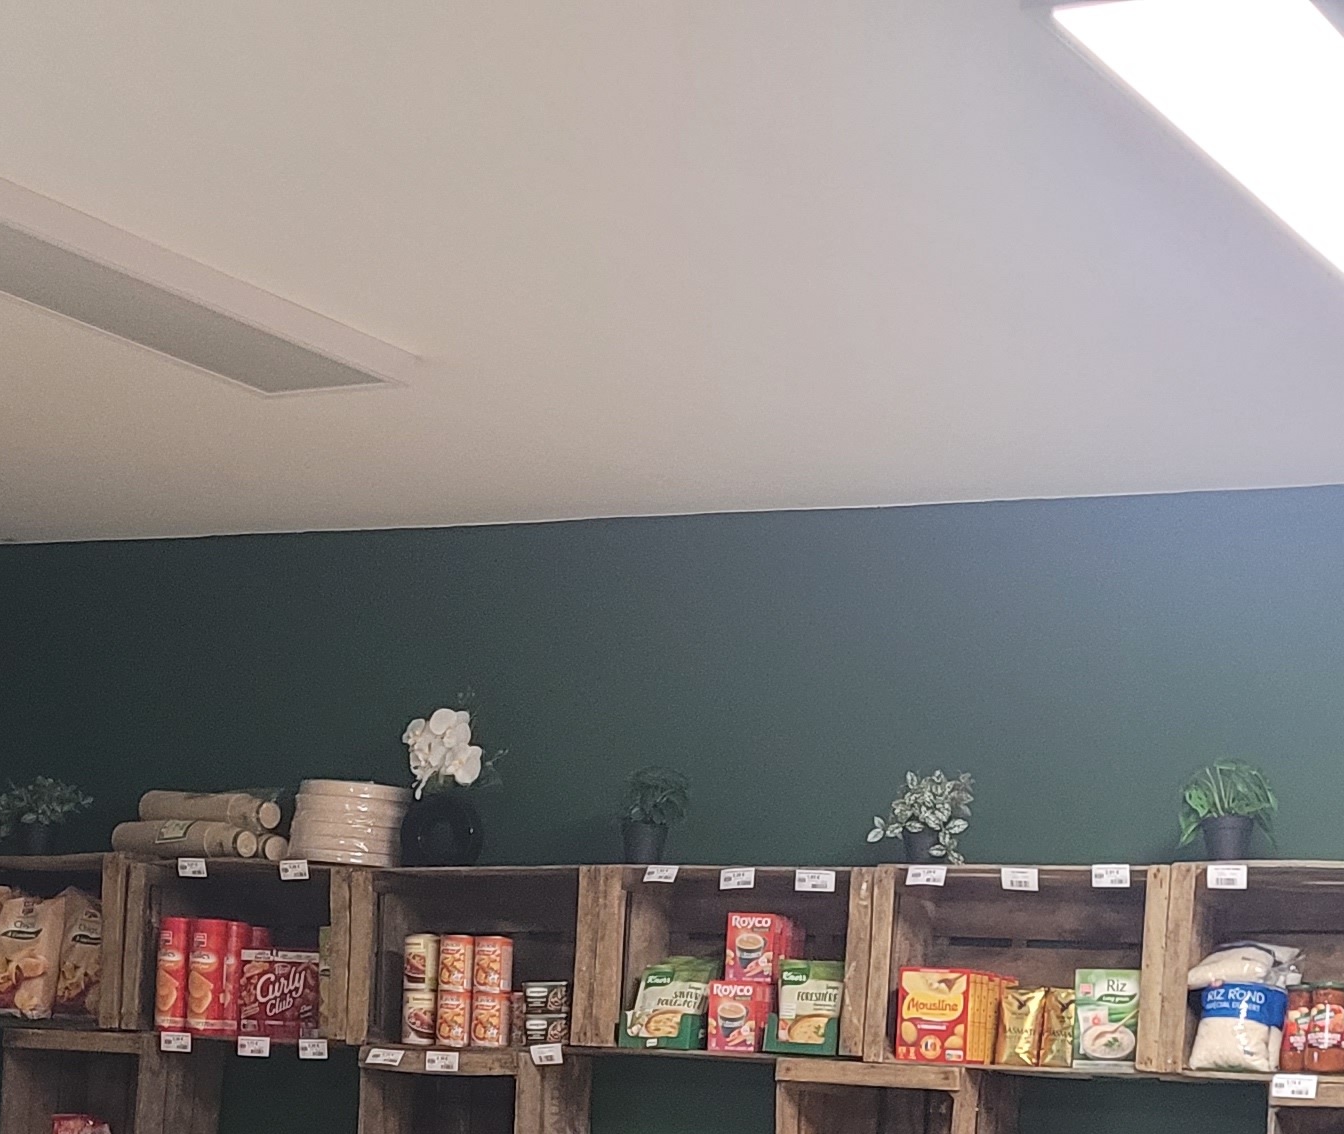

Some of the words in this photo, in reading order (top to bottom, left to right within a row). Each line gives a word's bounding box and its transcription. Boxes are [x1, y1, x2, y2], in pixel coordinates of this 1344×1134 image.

[731, 915, 772, 929] Royco
[256, 967, 306, 1003] Curly
[713, 983, 753, 997] Royco
[1106, 978, 1127, 993] Riz
[1207, 988, 1225, 1001] RIZ
[1227, 987, 1266, 1004] ROND
[266, 996, 294, 1016] Club
[907, 998, 958, 1013] Mousline
